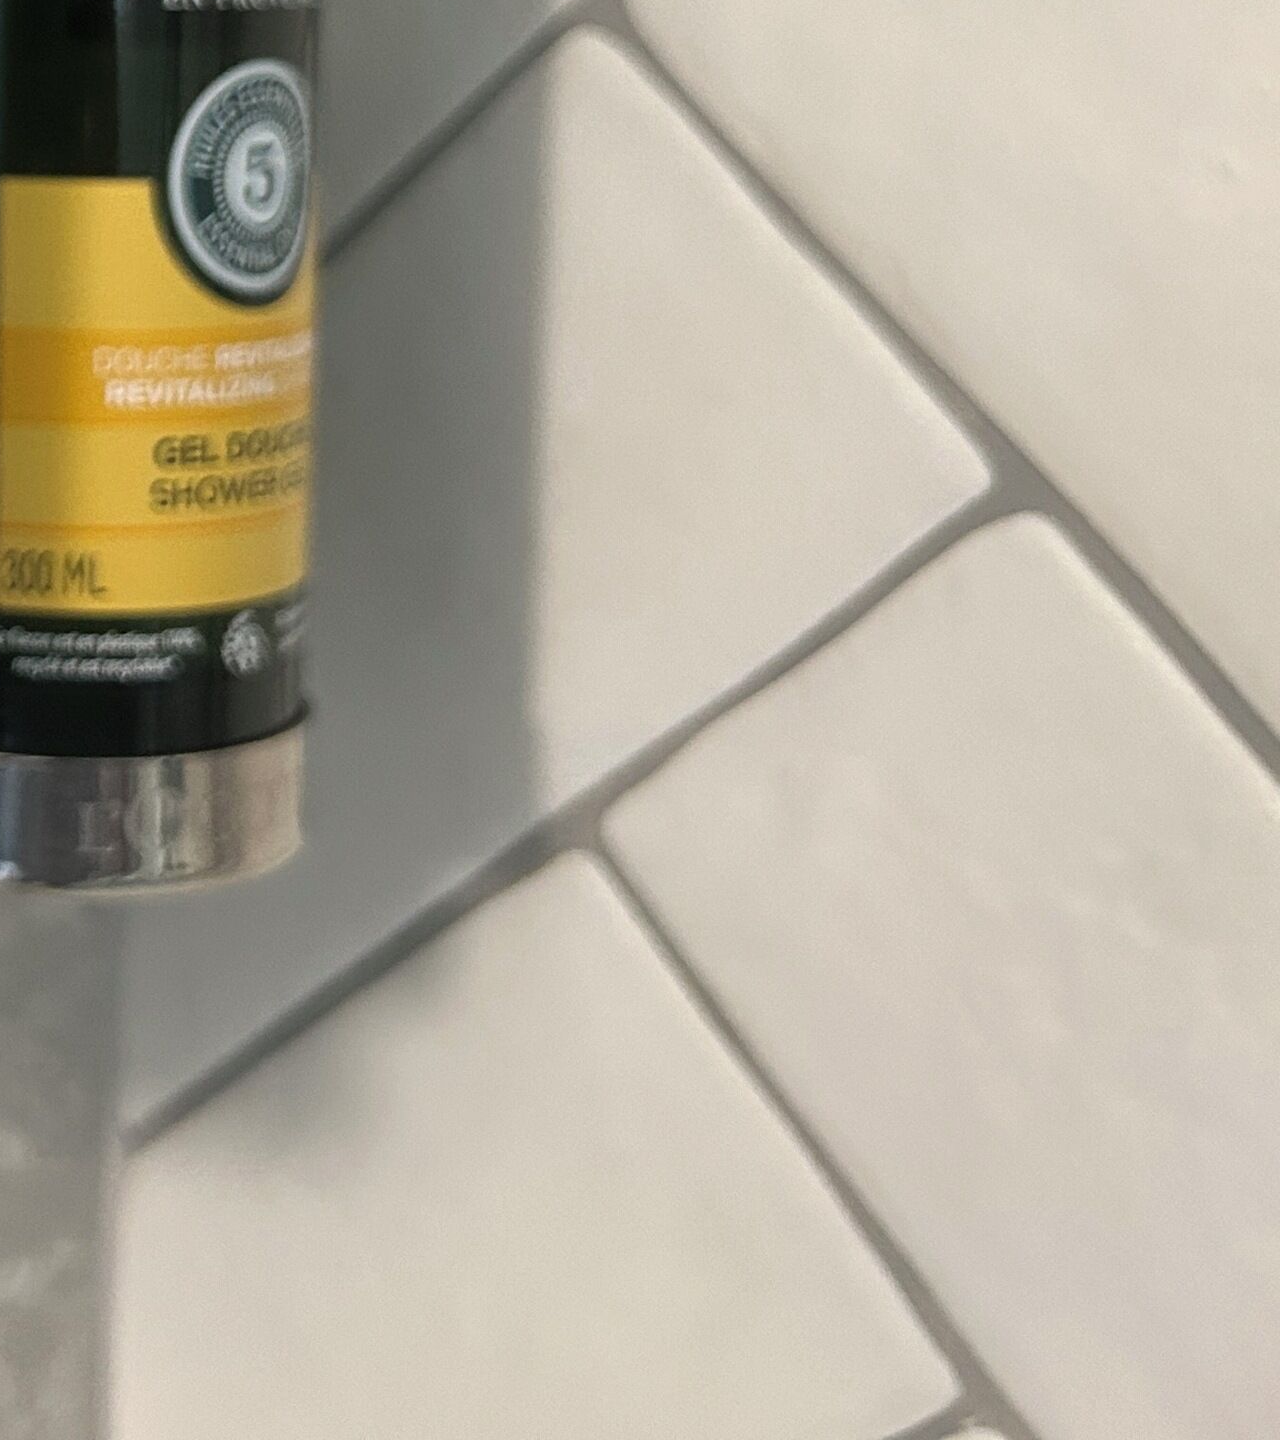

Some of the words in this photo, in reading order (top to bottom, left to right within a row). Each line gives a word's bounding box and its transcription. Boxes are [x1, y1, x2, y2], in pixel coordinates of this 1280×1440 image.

[242, 138, 275, 208] 5
[153, 435, 220, 469] GEL
[61, 552, 106, 597] ML
